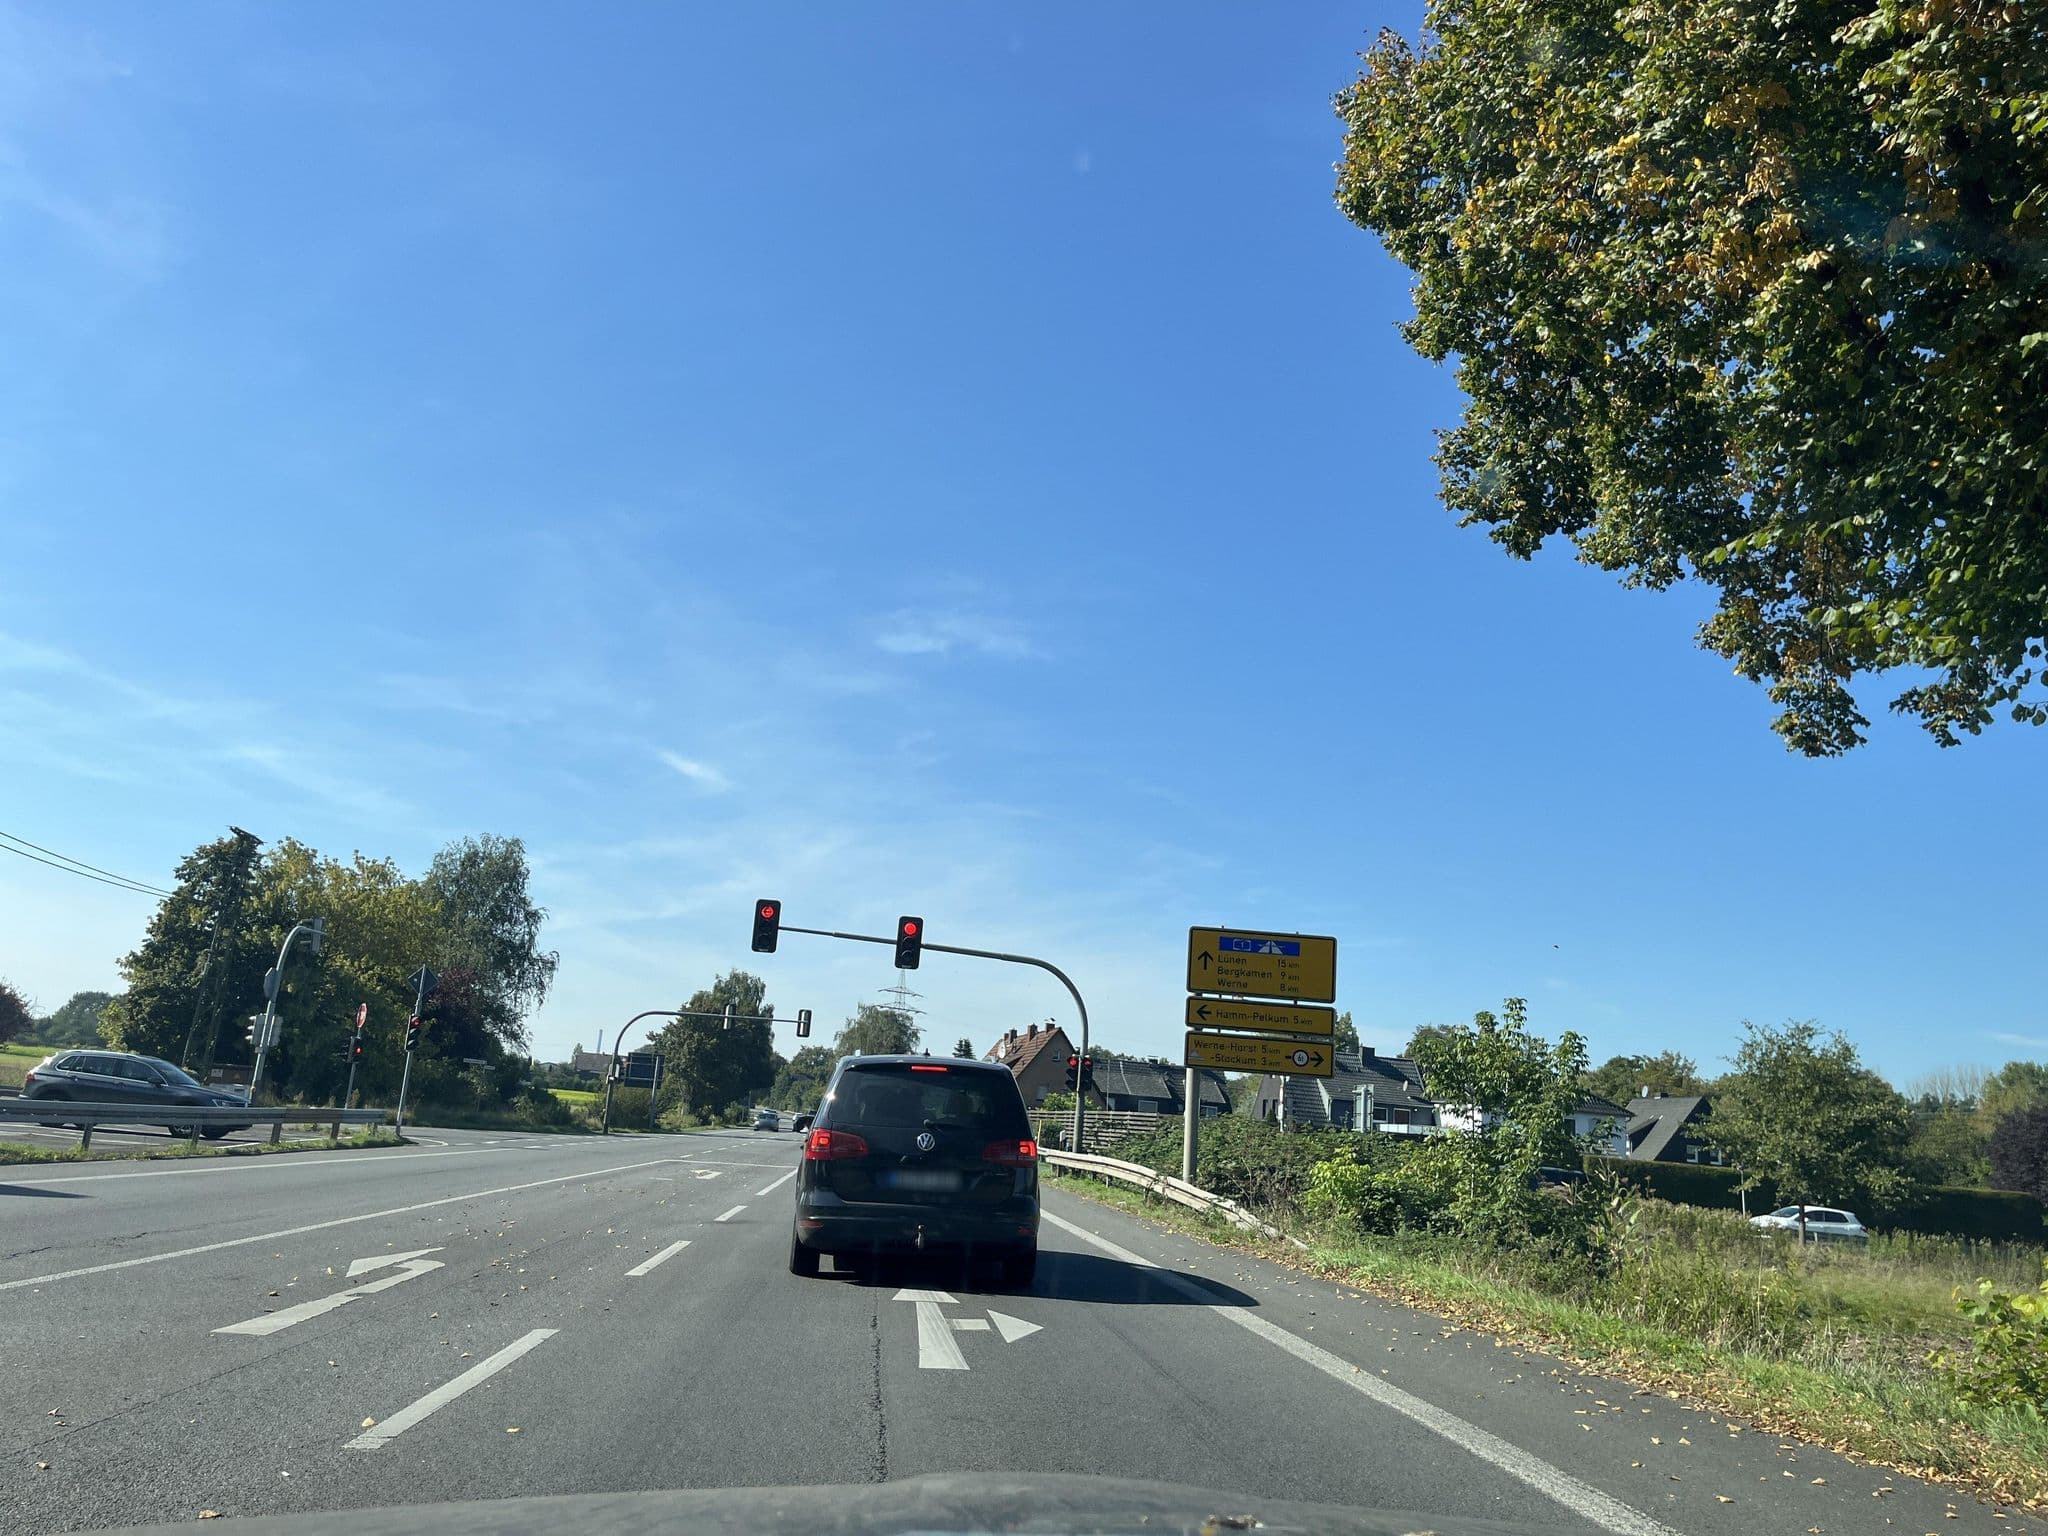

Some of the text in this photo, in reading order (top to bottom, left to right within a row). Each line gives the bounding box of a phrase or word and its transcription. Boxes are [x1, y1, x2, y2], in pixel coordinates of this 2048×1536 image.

[1277, 959, 1287, 969] 15
[1217, 967, 1272, 979] Bergkamen
[1280, 971, 1286, 980] 9
[1217, 978, 1248, 988] Werne
[1280, 983, 1286, 992] 8
[1216, 1009, 1289, 1023] Hamm-Pelkum
[1293, 1015, 1299, 1025] 5
[1194, 1040, 1257, 1052] Werne-Horst
[1261, 1044, 1267, 1054] 5
[1261, 1056, 1267, 1066] 3
